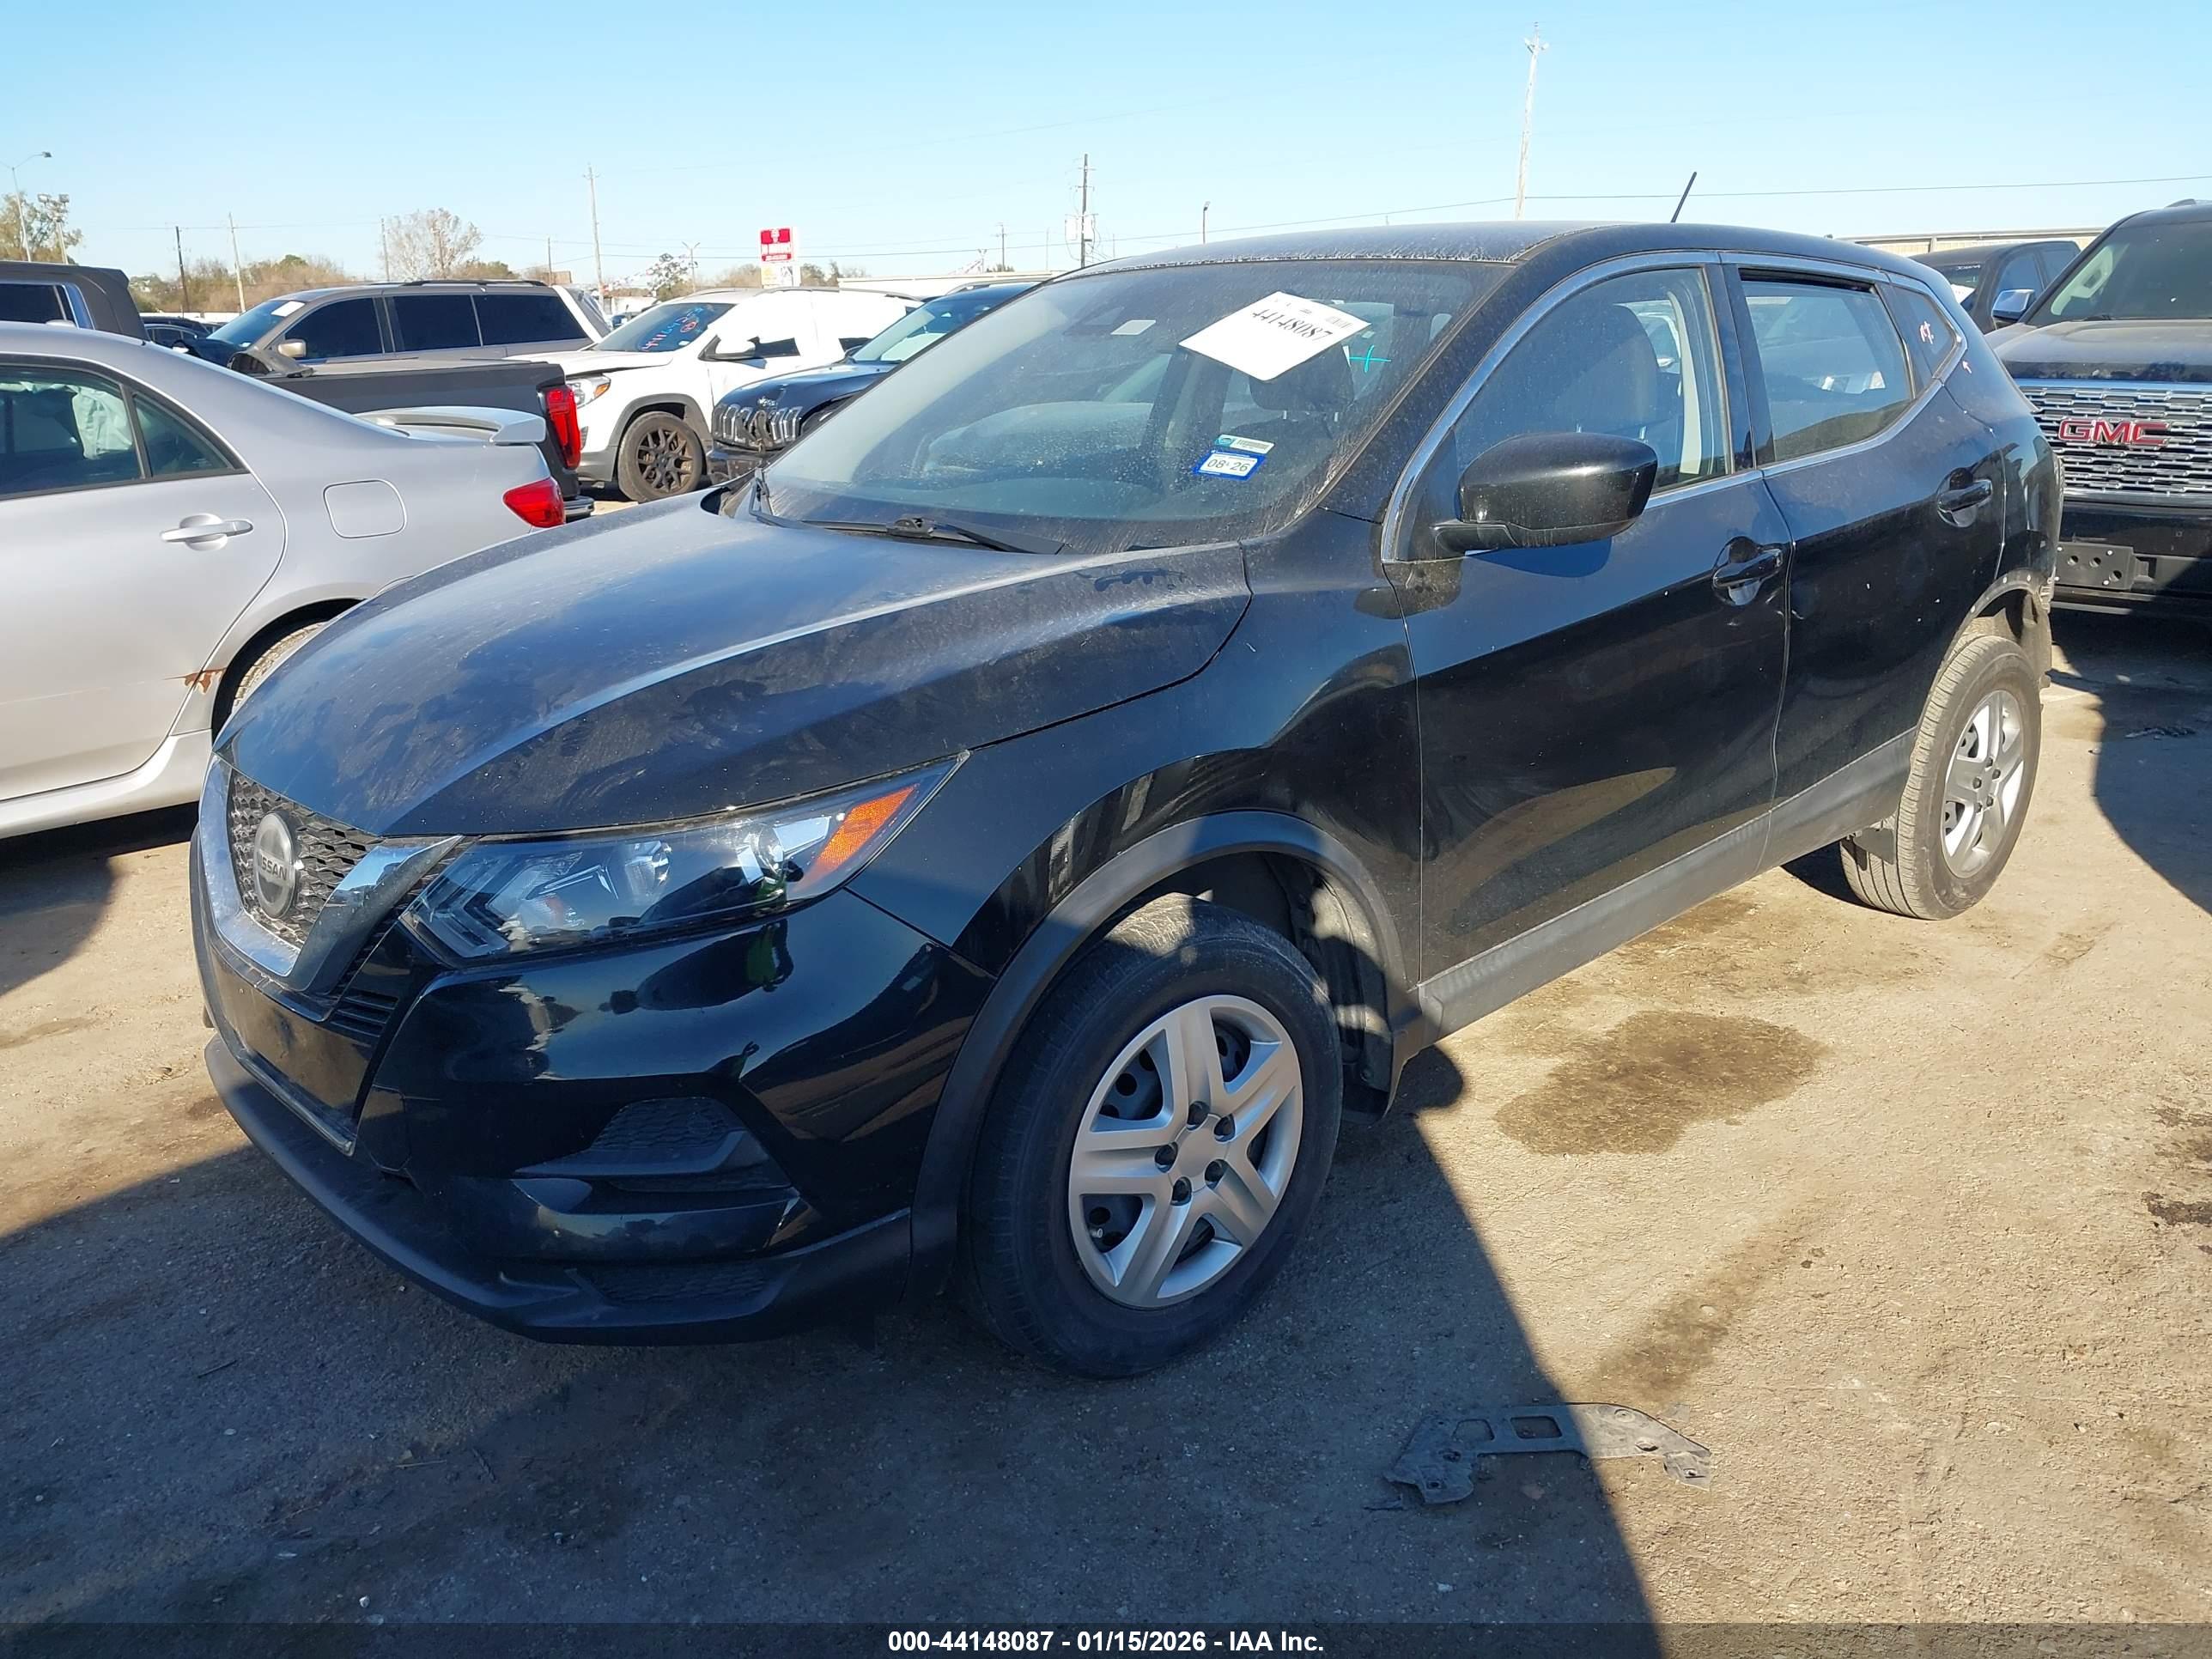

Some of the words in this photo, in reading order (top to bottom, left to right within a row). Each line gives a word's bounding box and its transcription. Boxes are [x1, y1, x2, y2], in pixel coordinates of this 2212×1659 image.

[1252, 308, 1334, 342] 44148087
[2058, 417, 2170, 447] GMC
[1206, 458, 1226, 469] 08
[1229, 460, 1251, 472] 26
